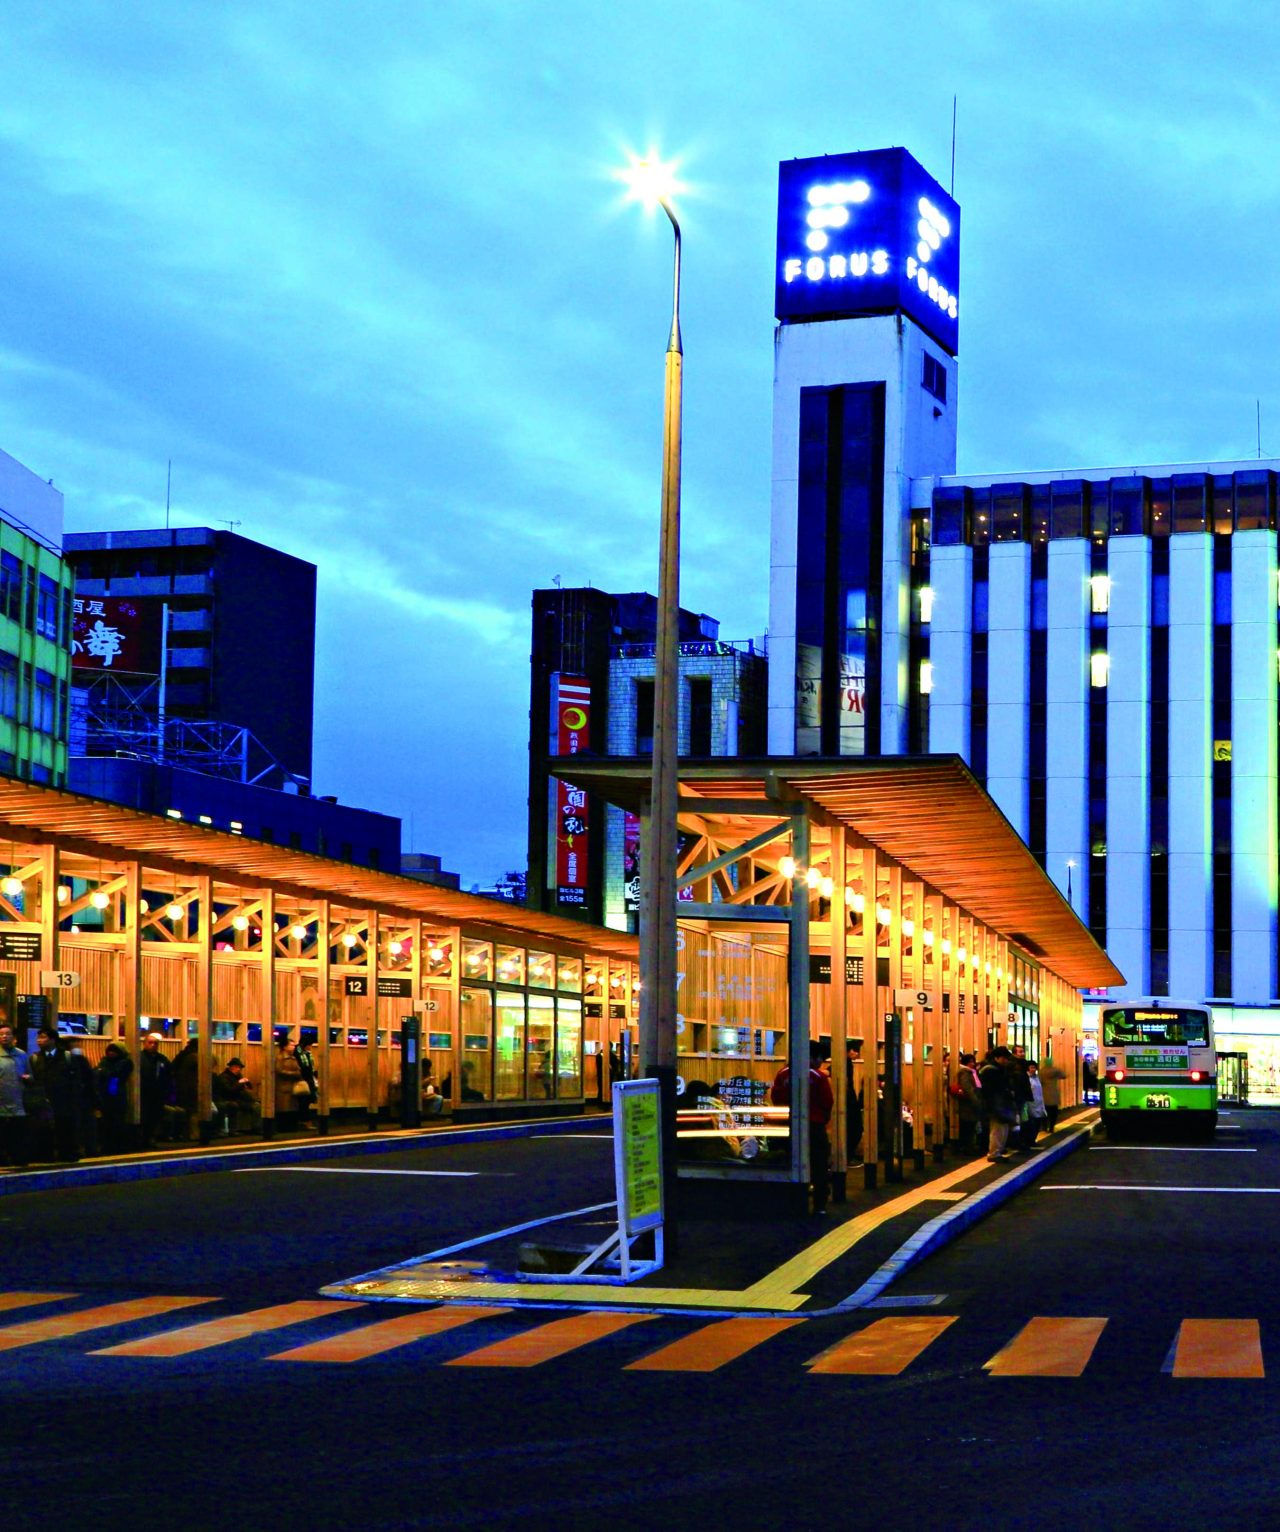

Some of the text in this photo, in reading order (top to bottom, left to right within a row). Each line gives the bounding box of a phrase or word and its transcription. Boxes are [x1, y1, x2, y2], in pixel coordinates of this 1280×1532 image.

[785, 250, 889, 283] FORUS
[57, 973, 73, 986] 13
[348, 981, 362, 993] 12
[916, 992, 928, 1005] 9
[424, 1002, 436, 1011] 12
[885, 1014, 893, 1022] 9
[1008, 1013, 1016, 1022] 8
